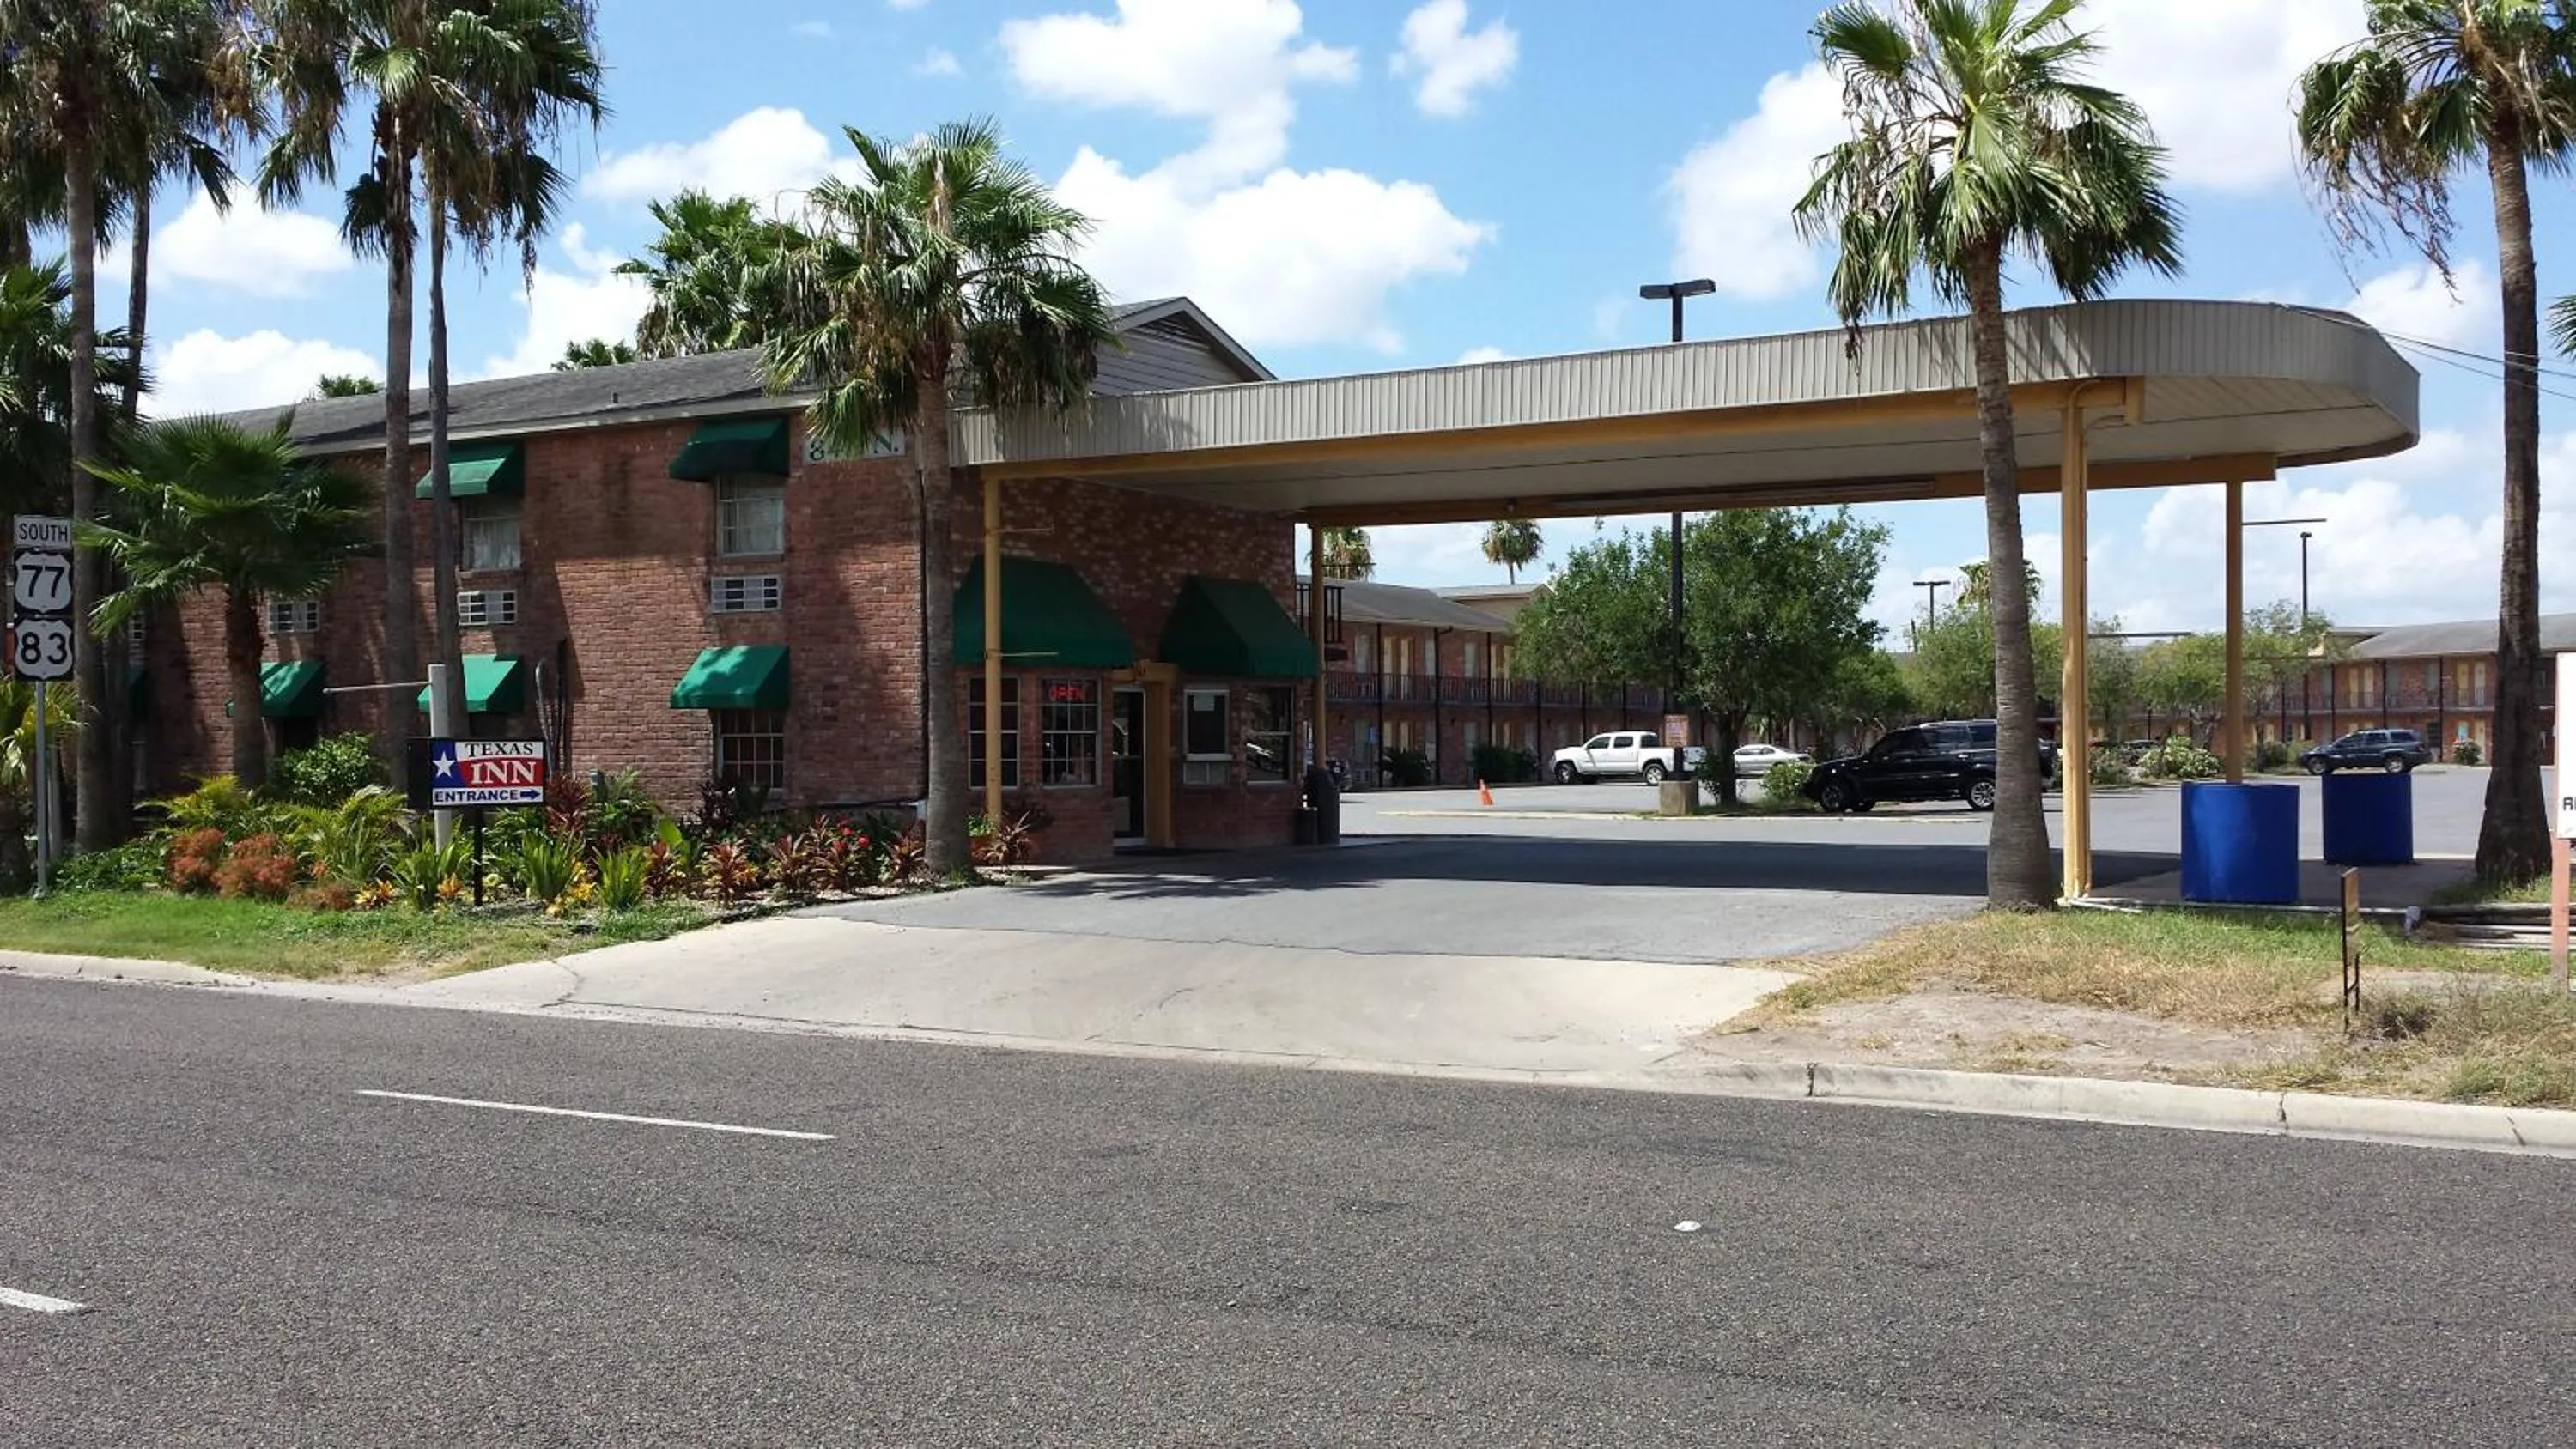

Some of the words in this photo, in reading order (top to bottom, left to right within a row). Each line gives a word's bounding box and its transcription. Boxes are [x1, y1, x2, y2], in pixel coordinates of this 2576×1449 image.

[19, 523, 68, 542] SOUTH
[22, 565, 64, 597] 77
[21, 632, 67, 664] 83
[1049, 685, 1085, 701] OPEN
[465, 743, 533, 757] TEXAS
[471, 760, 537, 784] INN
[434, 790, 519, 803] ENTRANCE
